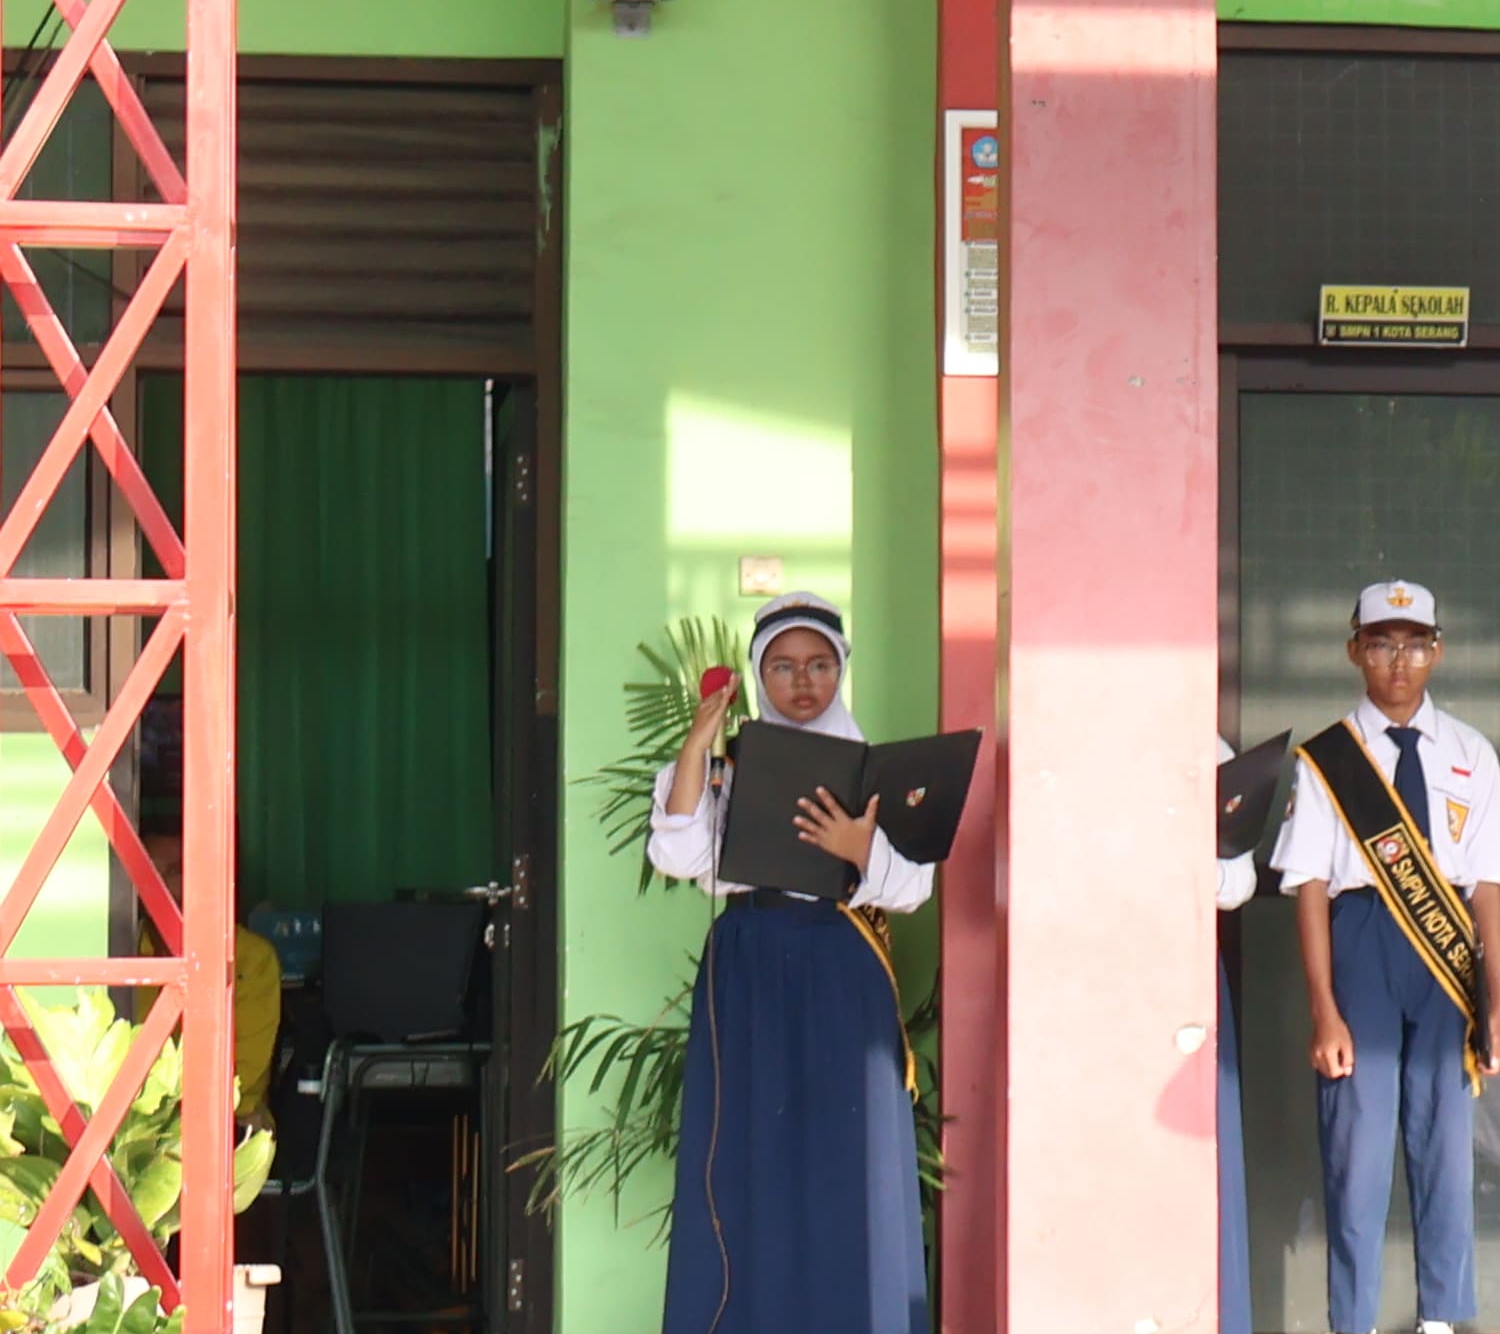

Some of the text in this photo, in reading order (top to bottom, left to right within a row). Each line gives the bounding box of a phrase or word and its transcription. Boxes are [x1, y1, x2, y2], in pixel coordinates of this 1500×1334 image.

[1326, 294, 1465, 316] R. KEPALA SEKOLAH
[1382, 325, 1412, 338] KOTA
[1415, 325, 1459, 339] SERANG
[1391, 856, 1430, 905] SMPN
[1415, 899, 1433, 915] 1
[1420, 912, 1457, 951] KOTA
